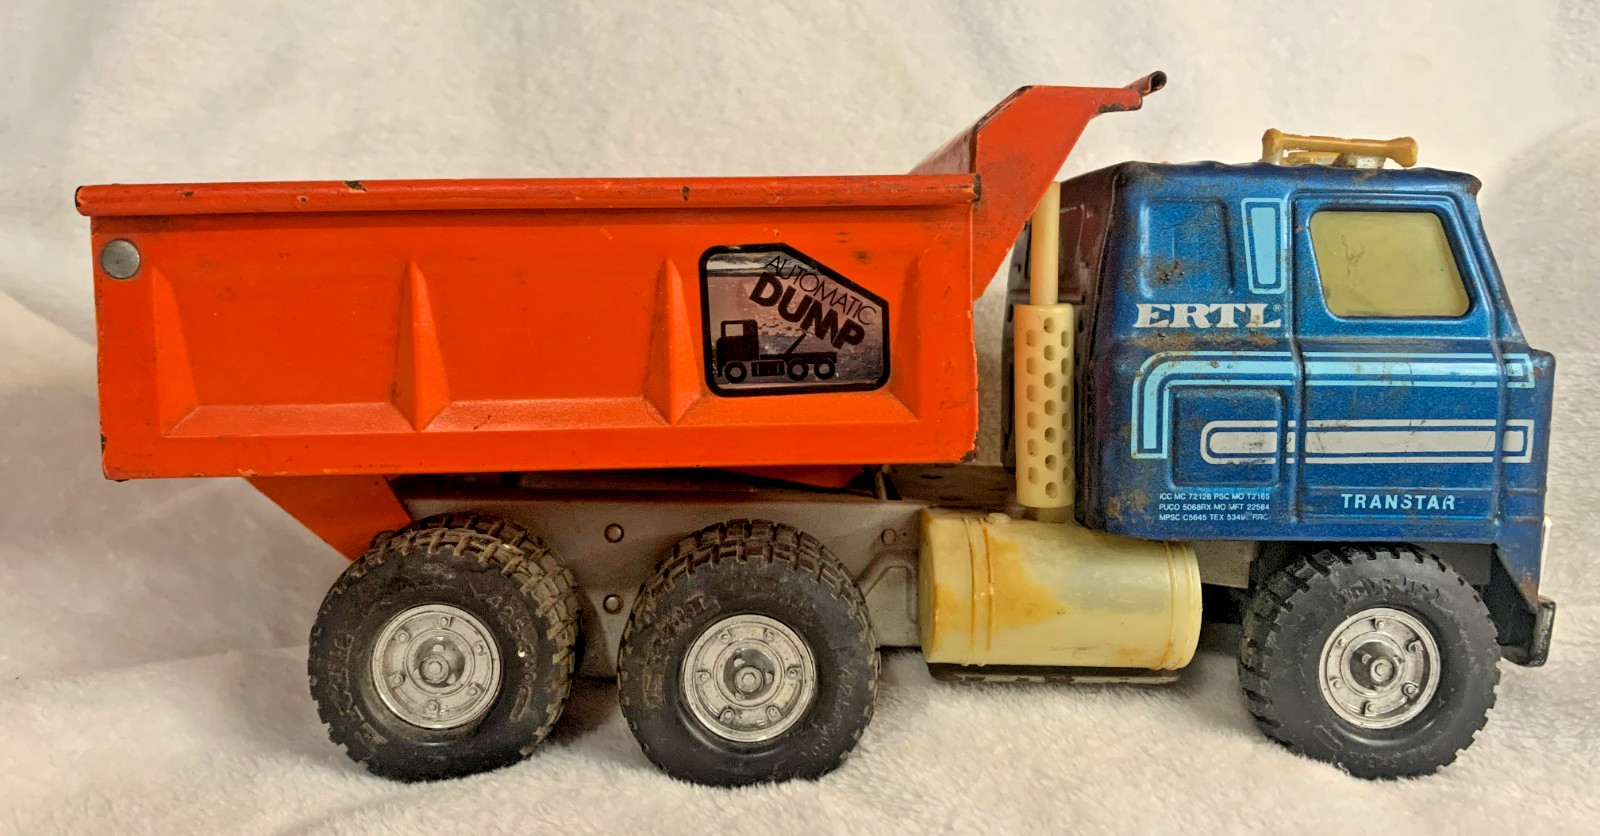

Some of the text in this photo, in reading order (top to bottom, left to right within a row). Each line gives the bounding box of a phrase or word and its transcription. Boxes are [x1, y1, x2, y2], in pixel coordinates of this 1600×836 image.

[764, 255, 878, 326] AUTOMATIC
[749, 272, 865, 350] DUMP
[1159, 492, 1172, 500] ICC
[1174, 492, 1186, 500] MC
[1213, 492, 1229, 500] PSC
[1231, 492, 1245, 500] MO
[1246, 492, 1270, 500] T2165
[1341, 493, 1455, 510] TRANSTAR
[1158, 503, 1180, 511] PUCO
[1213, 503, 1227, 511] MO
[1158, 513, 1181, 521] MPSC
[1210, 513, 1224, 521] TEX
